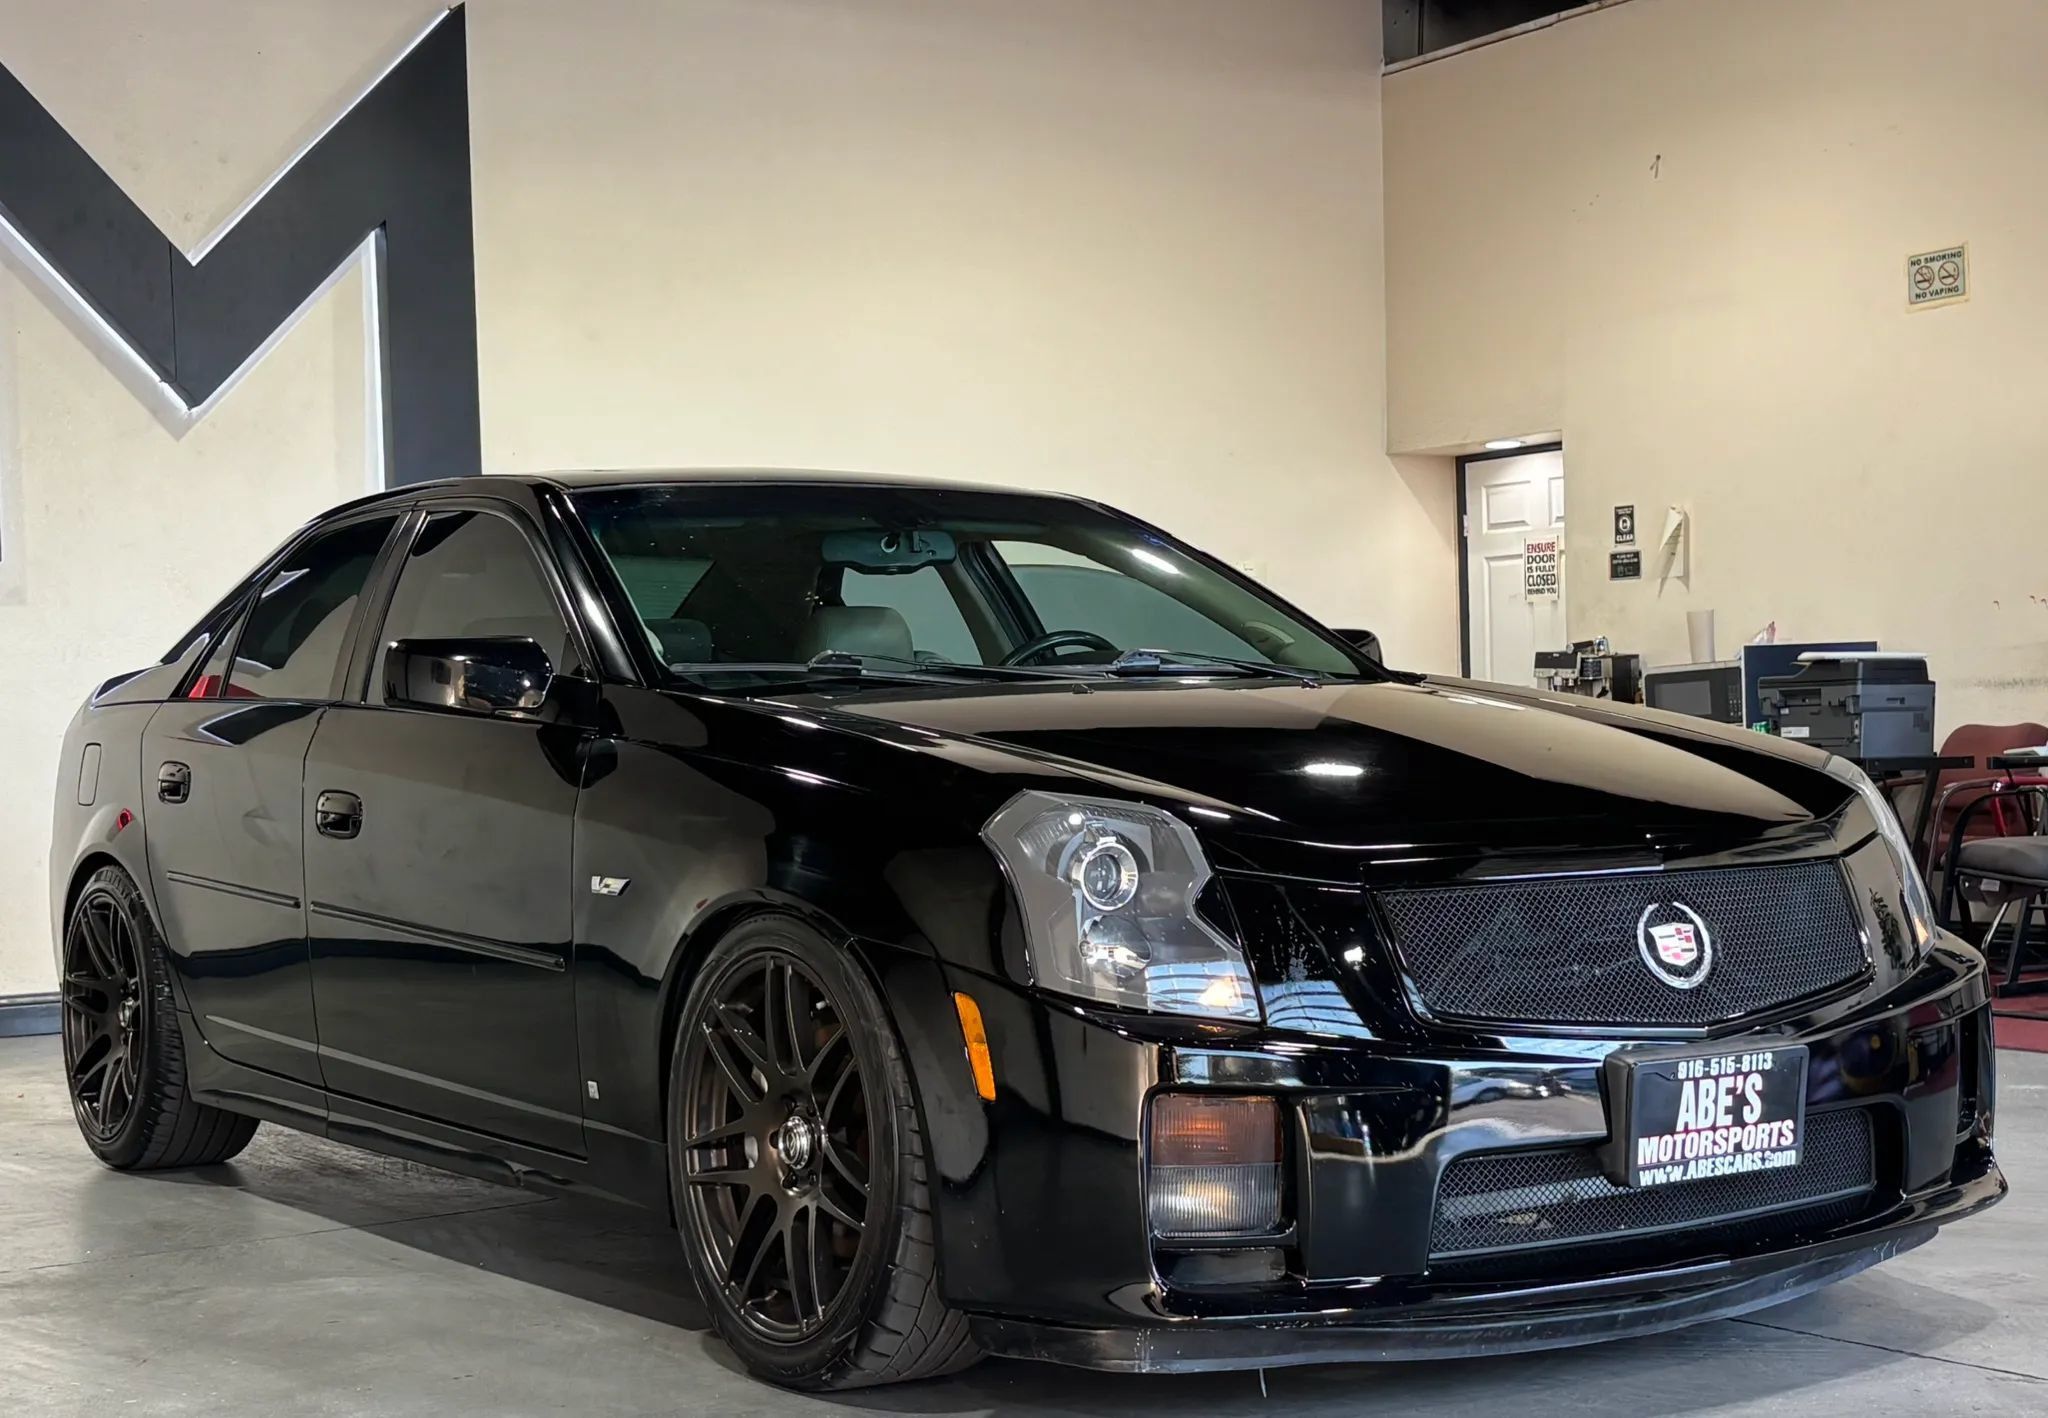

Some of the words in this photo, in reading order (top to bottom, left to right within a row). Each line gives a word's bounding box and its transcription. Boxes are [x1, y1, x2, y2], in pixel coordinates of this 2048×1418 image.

[1910, 259, 1922, 267] NO
[1924, 251, 1962, 264] SMOKING
[1915, 292, 1927, 300] NO
[1928, 285, 1960, 297] VAPING
[1527, 541, 1556, 554] ENSURE
[1527, 553, 1556, 565] DOOR
[1535, 565, 1555, 573] FULLY
[1527, 573, 1556, 587] CLOSED
[1675, 1072, 1764, 1132] ABE'S
[1637, 1119, 1795, 1166] MOTORSPORTS
